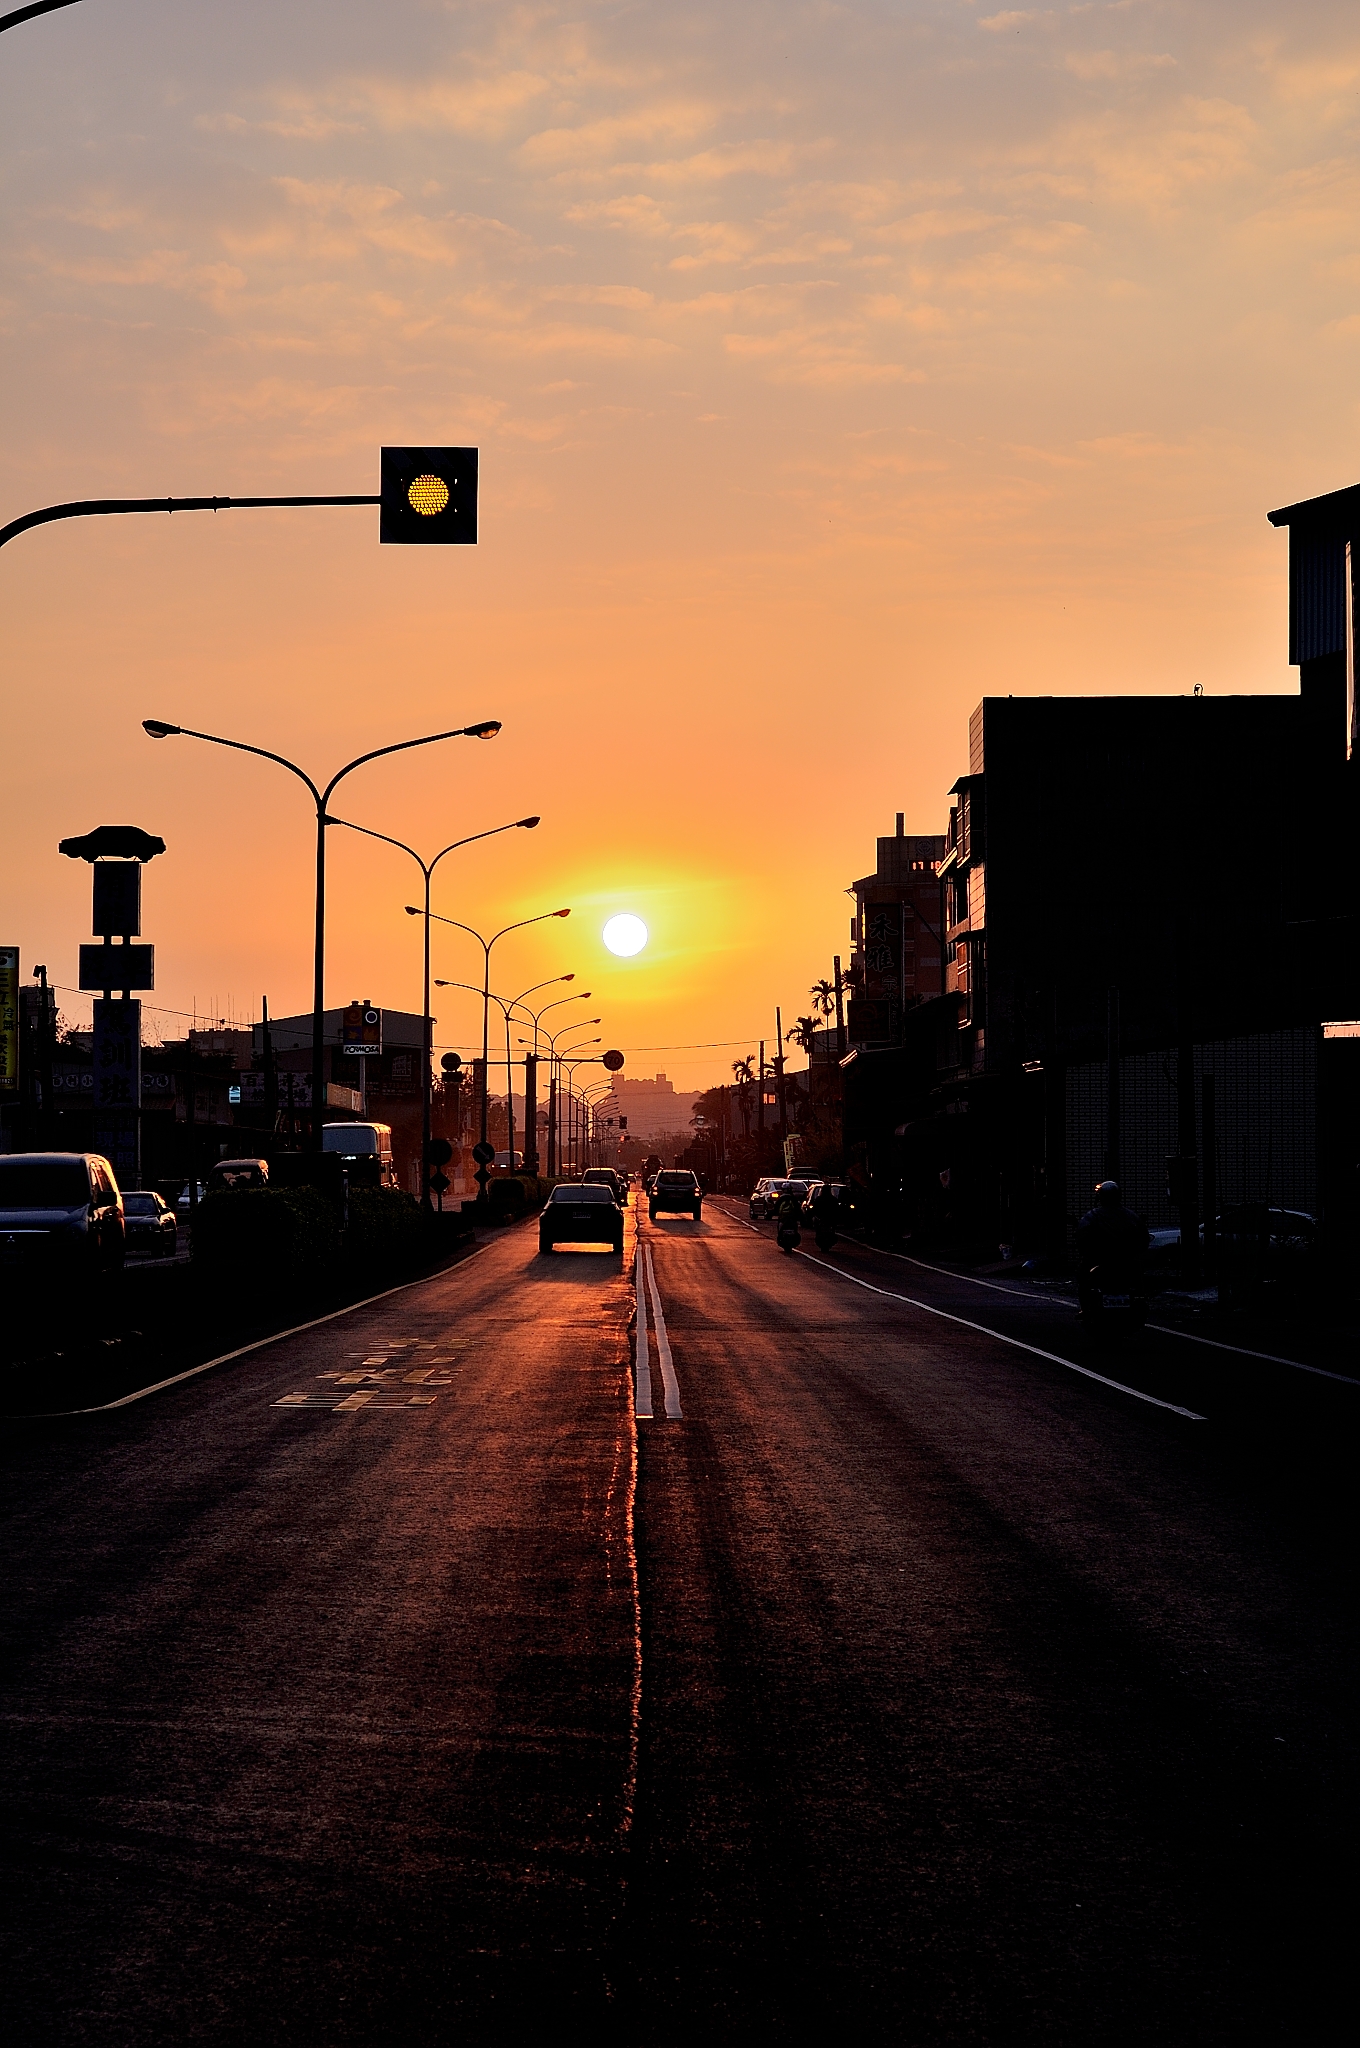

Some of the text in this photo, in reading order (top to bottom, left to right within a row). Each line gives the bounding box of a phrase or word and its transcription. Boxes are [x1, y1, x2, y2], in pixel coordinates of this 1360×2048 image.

[98, 865, 132, 934] 有能
[867, 912, 900, 973] 禾雅
[82, 951, 149, 984] 汽車
[98, 1001, 135, 1104] 駕訓班
[344, 1046, 380, 1054] FORMOSA
[607, 1056, 621, 1065] 70
[95, 1131, 136, 1148] 現場
